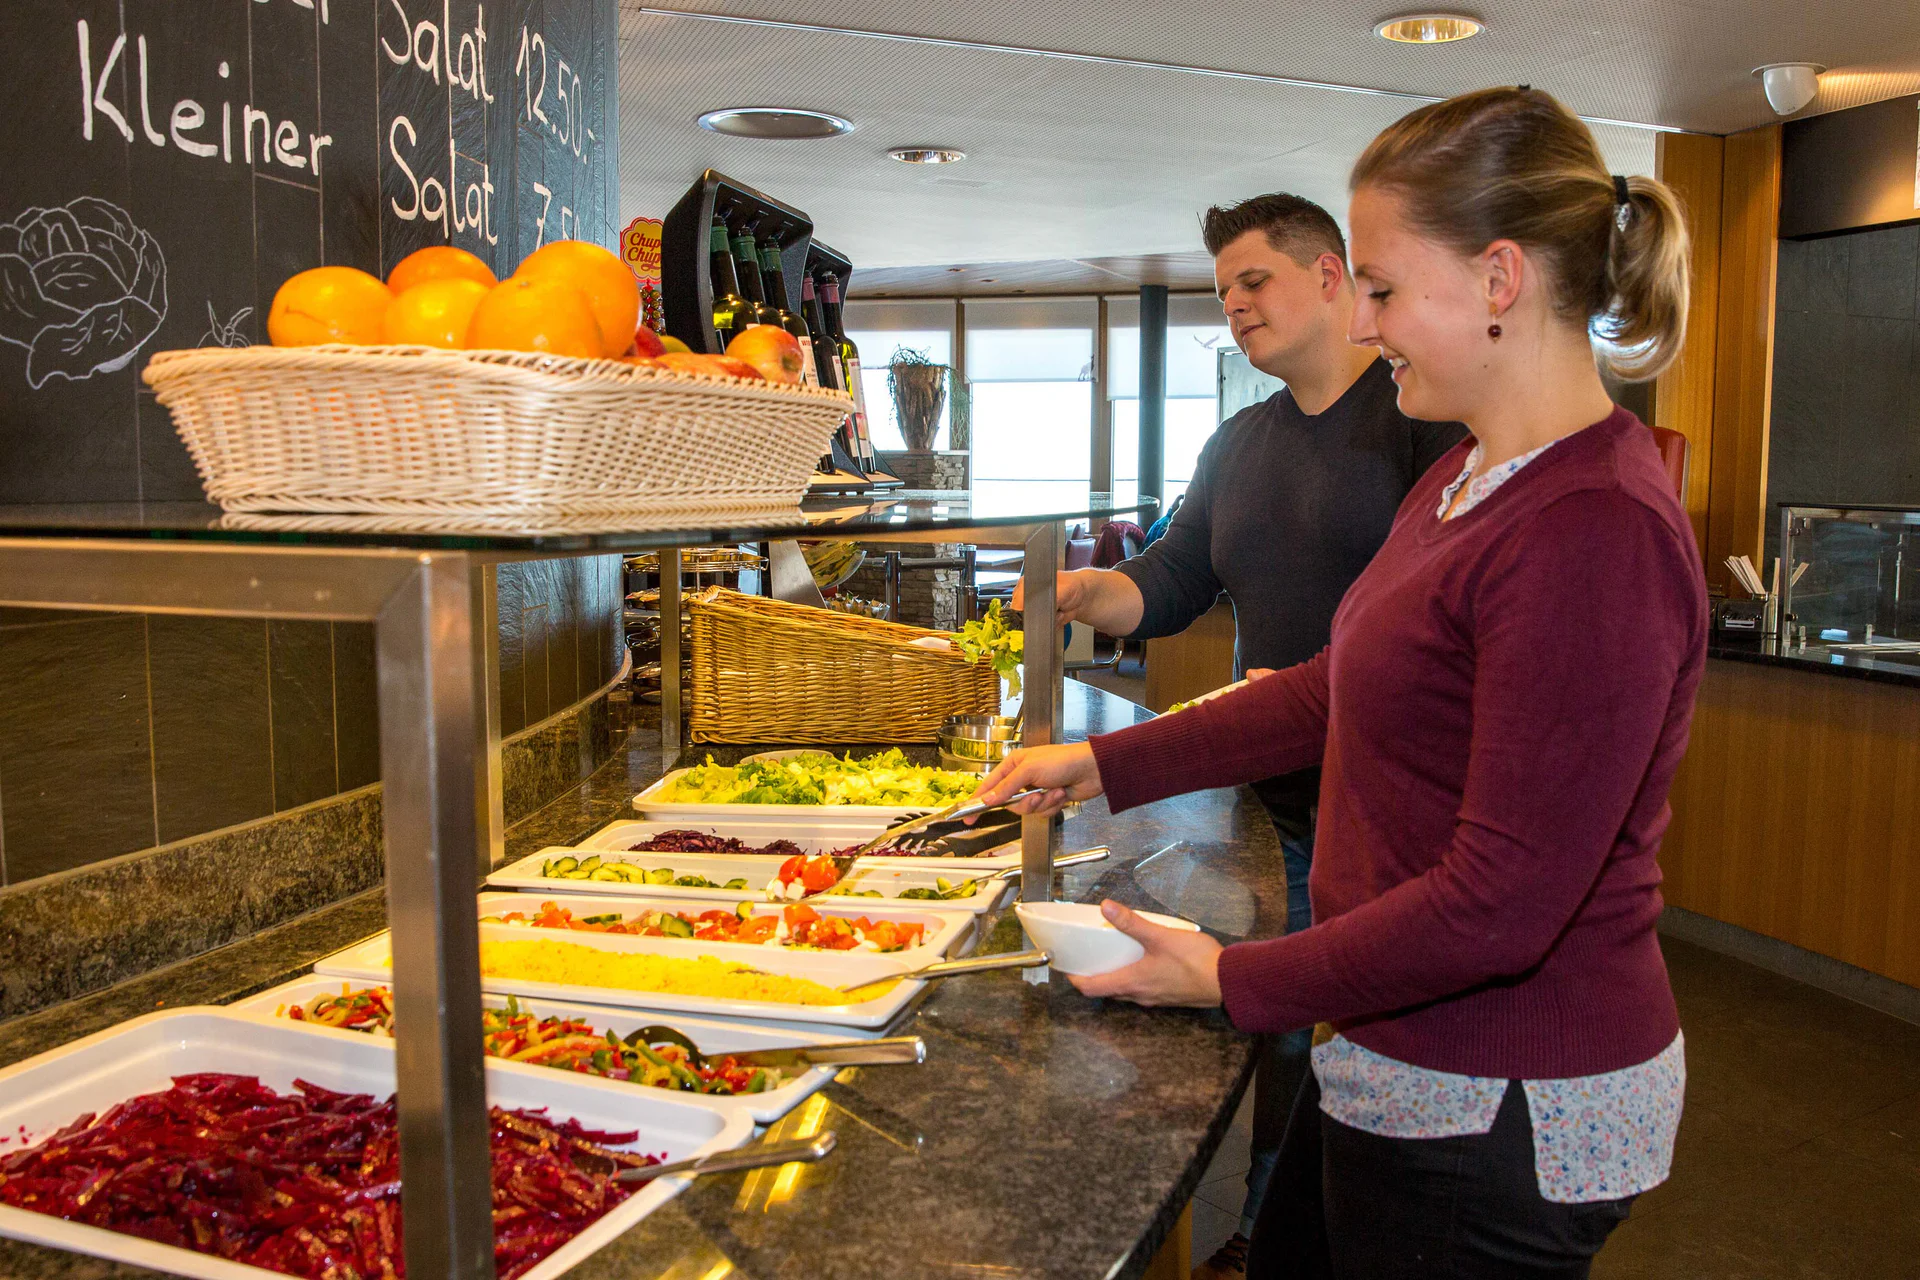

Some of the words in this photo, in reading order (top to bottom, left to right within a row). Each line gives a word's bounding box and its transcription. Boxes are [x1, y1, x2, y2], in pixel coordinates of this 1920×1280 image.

[381, 0, 495, 104] Salat
[77, 19, 333, 177] Kleiner
[389, 115, 498, 246] Salat
[627, 246, 662, 272] Chup
[630, 231, 662, 252] Chup
